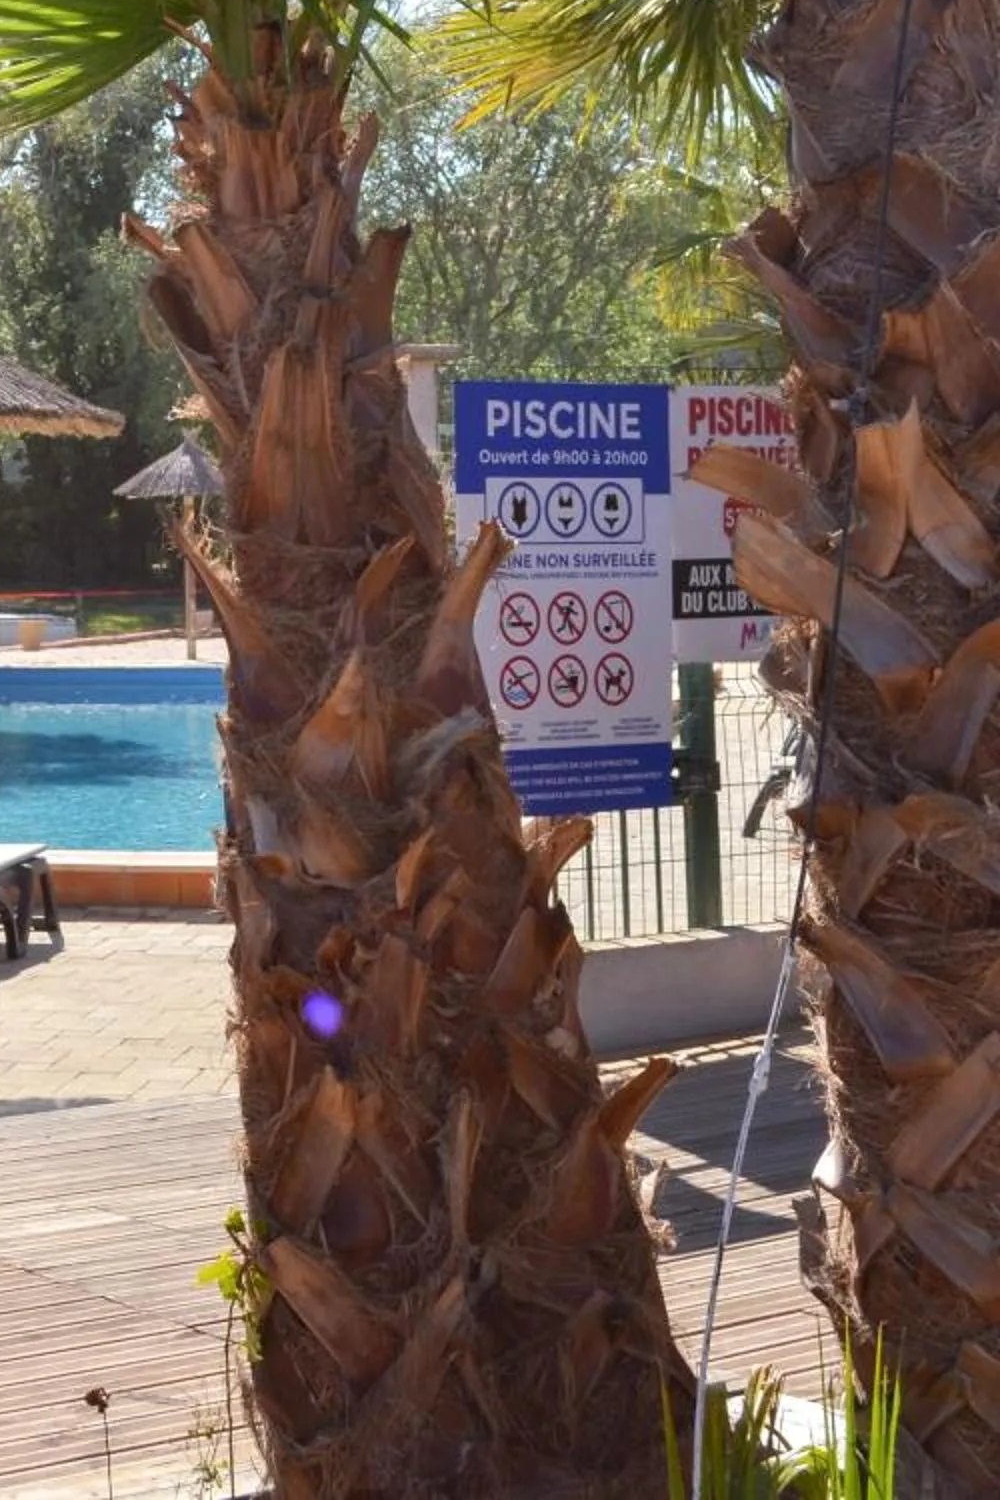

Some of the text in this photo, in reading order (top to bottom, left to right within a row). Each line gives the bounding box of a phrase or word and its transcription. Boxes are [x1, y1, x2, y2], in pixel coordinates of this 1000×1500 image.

[487, 400, 641, 439] PISCINE
[479, 449, 648, 465] Ouvert de 9h00 à 20h00
[536, 553, 569, 568] NON
[573, 550, 657, 567] SURVEILLÉE
[689, 564, 721, 587] AUX
[681, 591, 703, 613] DU
[707, 590, 748, 612] CLUB
